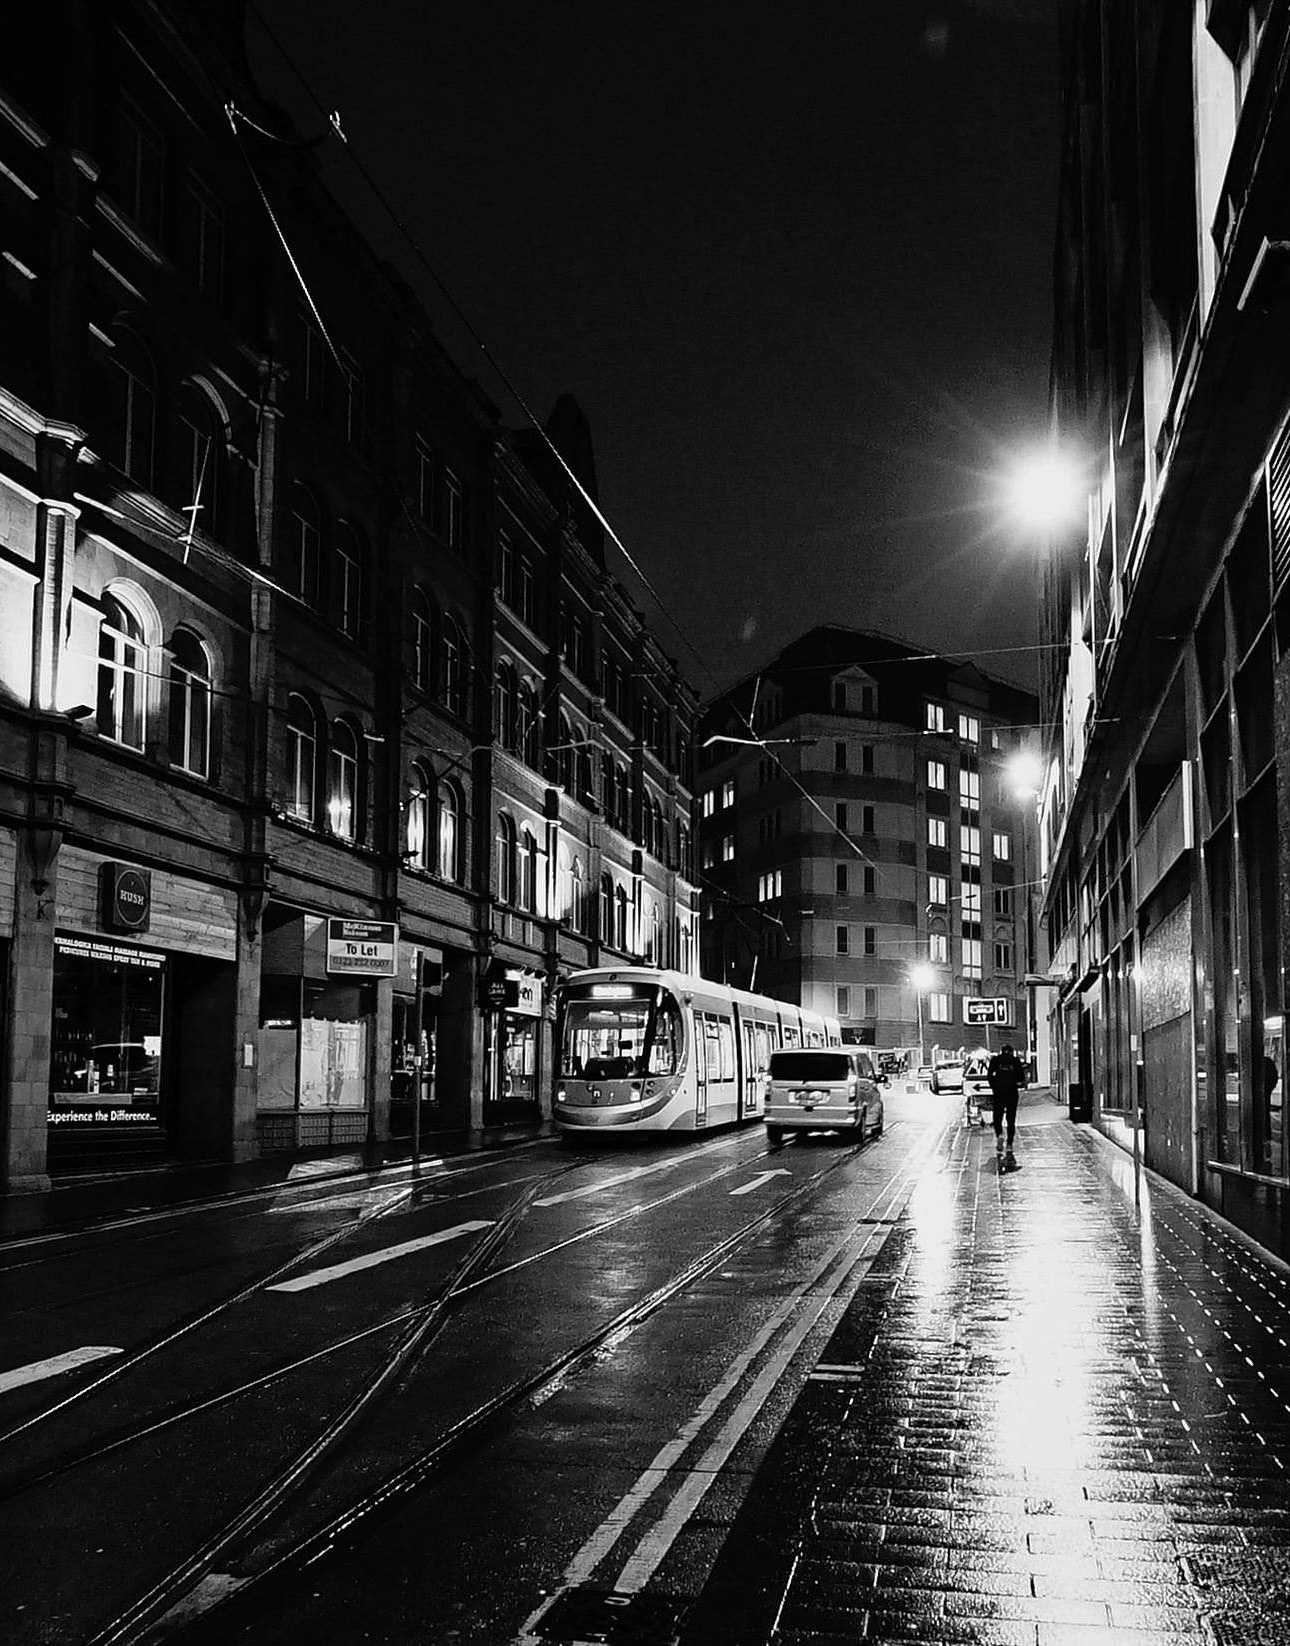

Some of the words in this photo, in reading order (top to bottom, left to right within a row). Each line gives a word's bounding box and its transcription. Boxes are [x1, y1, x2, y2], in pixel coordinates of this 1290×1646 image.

[120, 889, 145, 906] HUSH
[346, 943, 357, 955] To
[361, 944, 378, 956] Let
[47, 1110, 93, 1125] Experience
[95, 1110, 109, 1121] the
